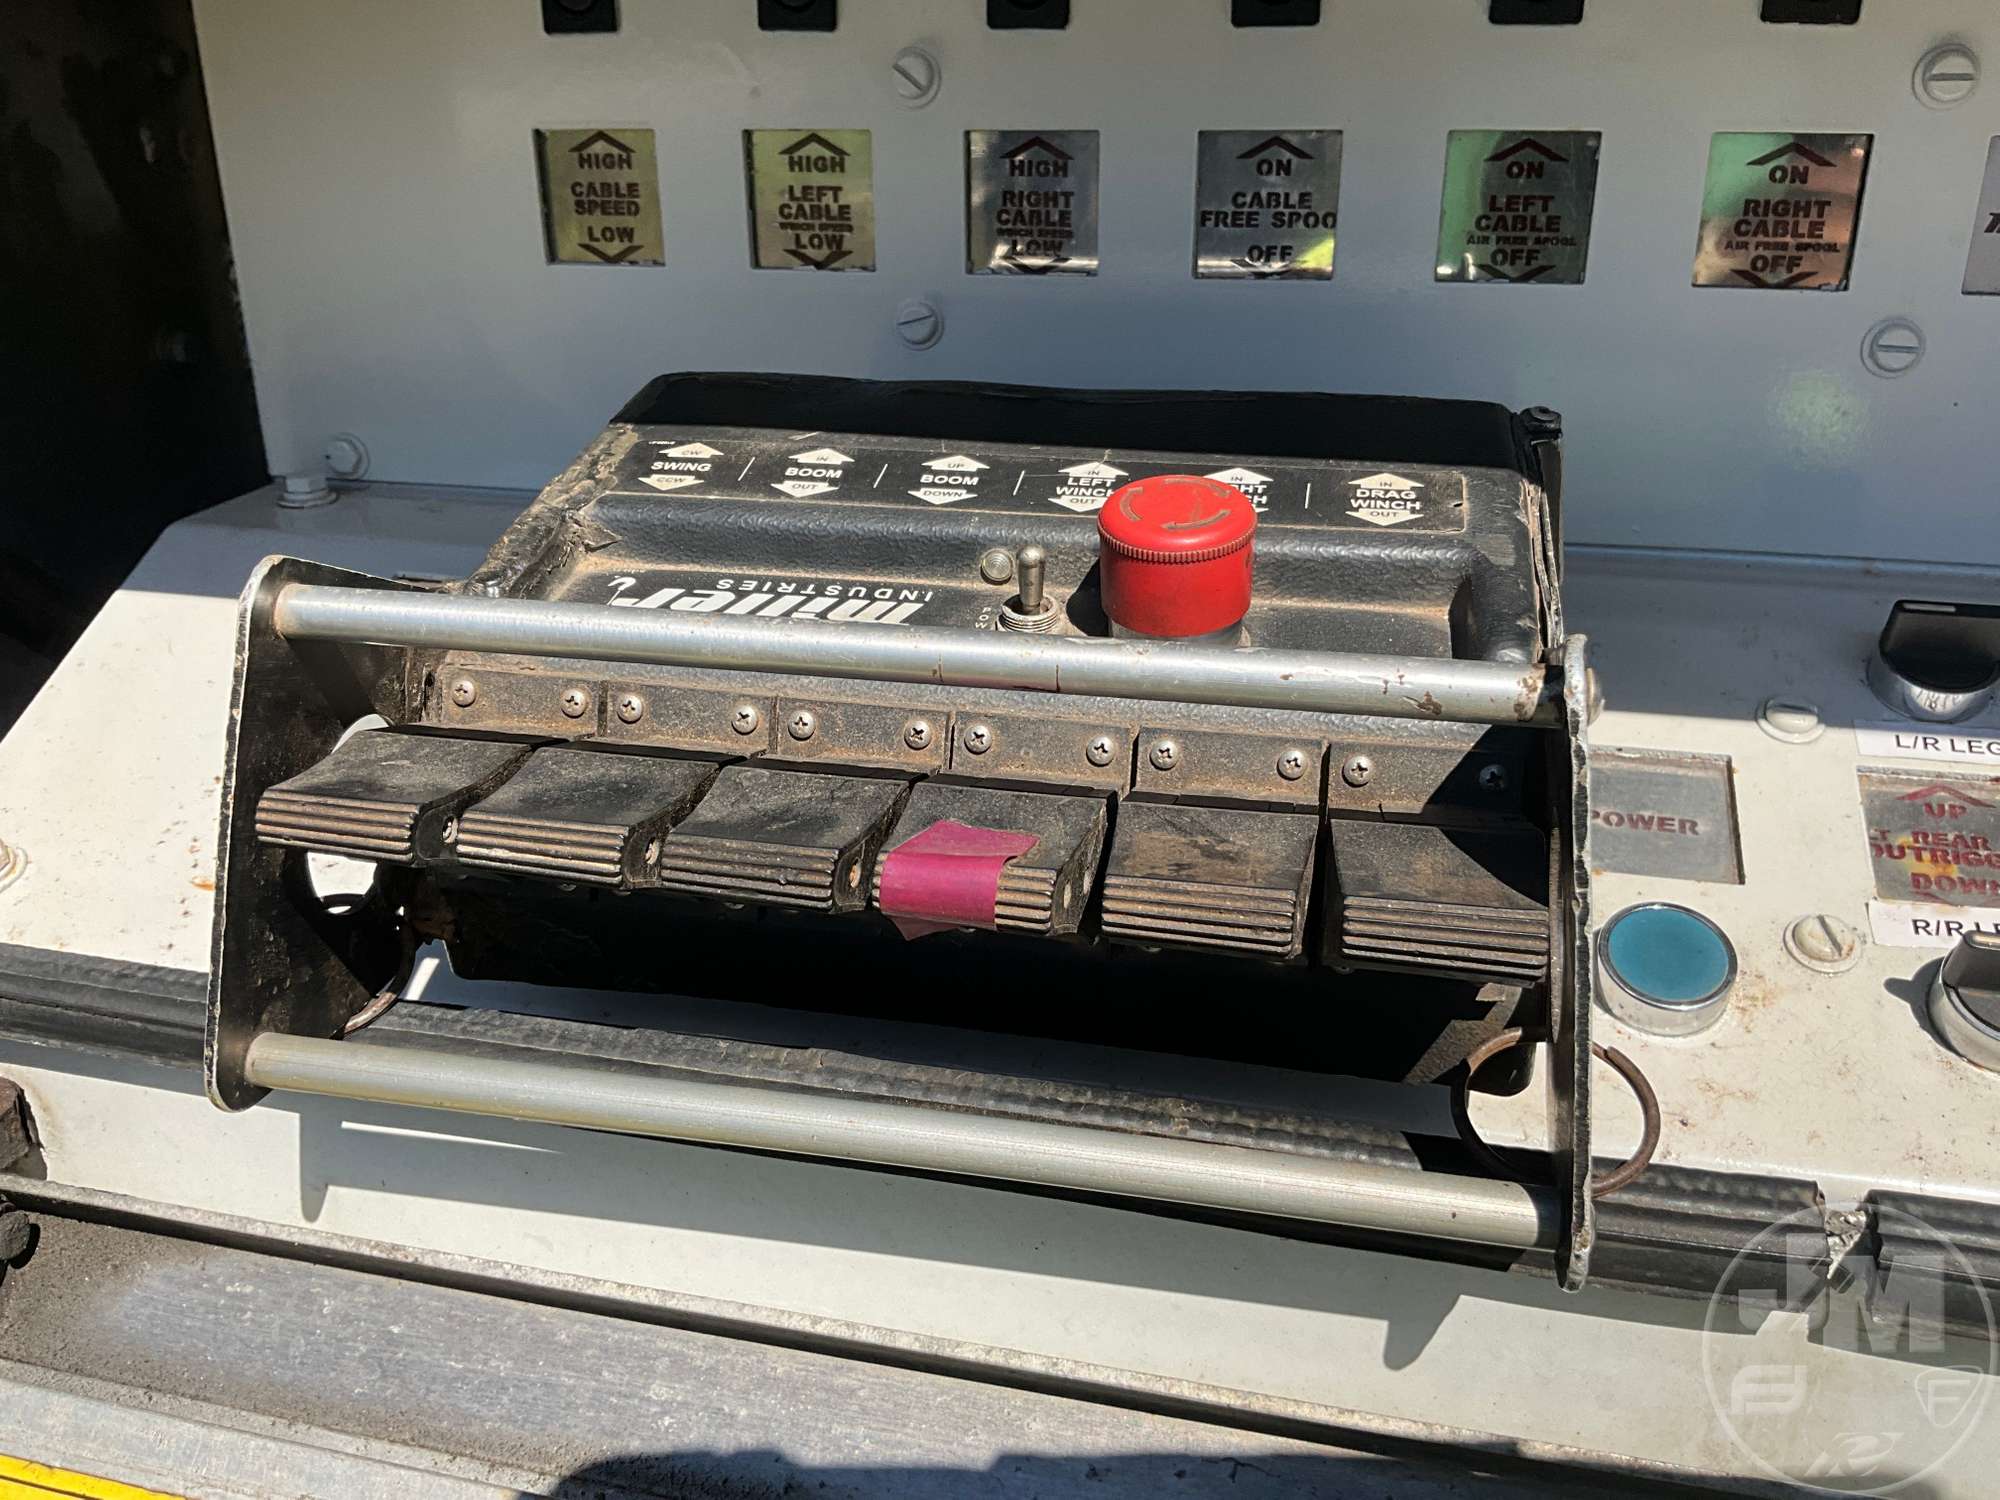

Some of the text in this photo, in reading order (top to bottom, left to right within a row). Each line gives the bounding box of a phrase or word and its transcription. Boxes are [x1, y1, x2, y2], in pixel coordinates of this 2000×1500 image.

[578, 153, 632, 169] HIGH
[788, 155, 845, 172] HIGH
[1009, 160, 1068, 177] HIGH
[1256, 159, 1292, 176] ON
[1505, 161, 1544, 178] ON
[1768, 165, 1809, 184] ON
[571, 182, 640, 199] CABLE
[788, 185, 843, 203] LEFT
[1002, 190, 1075, 208] RIGHT
[574, 200, 640, 216] SPEED
[1231, 191, 1312, 209] CABLE
[1488, 195, 1555, 212] LEFT
[1743, 199, 1831, 218] RIGHT
[778, 203, 851, 221] CABLE
[996, 208, 1072, 227] CABLE
[1200, 210, 1260, 228] FREE
[1474, 214, 1561, 232] CABLE
[1734, 219, 1825, 238] CABLE
[587, 226, 634, 243] LOW
[795, 233, 844, 250] LOW
[1466, 235, 1576, 246] AIR FREE SPOOL
[1012, 240, 1062, 257] LOW
[1247, 245, 1293, 262] OFF
[1724, 240, 1840, 253] AIR FREE SPOOL
[1490, 248, 1540, 266] OFF
[1750, 255, 1803, 273] OFF
[651, 461, 712, 472] SWING
[784, 467, 842, 478] BOOM
[920, 475, 979, 485] BOOM
[1067, 477, 1116, 487] LEFT
[1355, 489, 1416, 499] DRAG
[1350, 499, 1421, 510] WINCH
[716, 578, 935, 602] INDUSTRIES
[1895, 735, 1941, 751] L/R
[1924, 803, 1967, 819] UP
[1911, 831, 1992, 850] REAR
[1912, 919, 1964, 936] R/R
